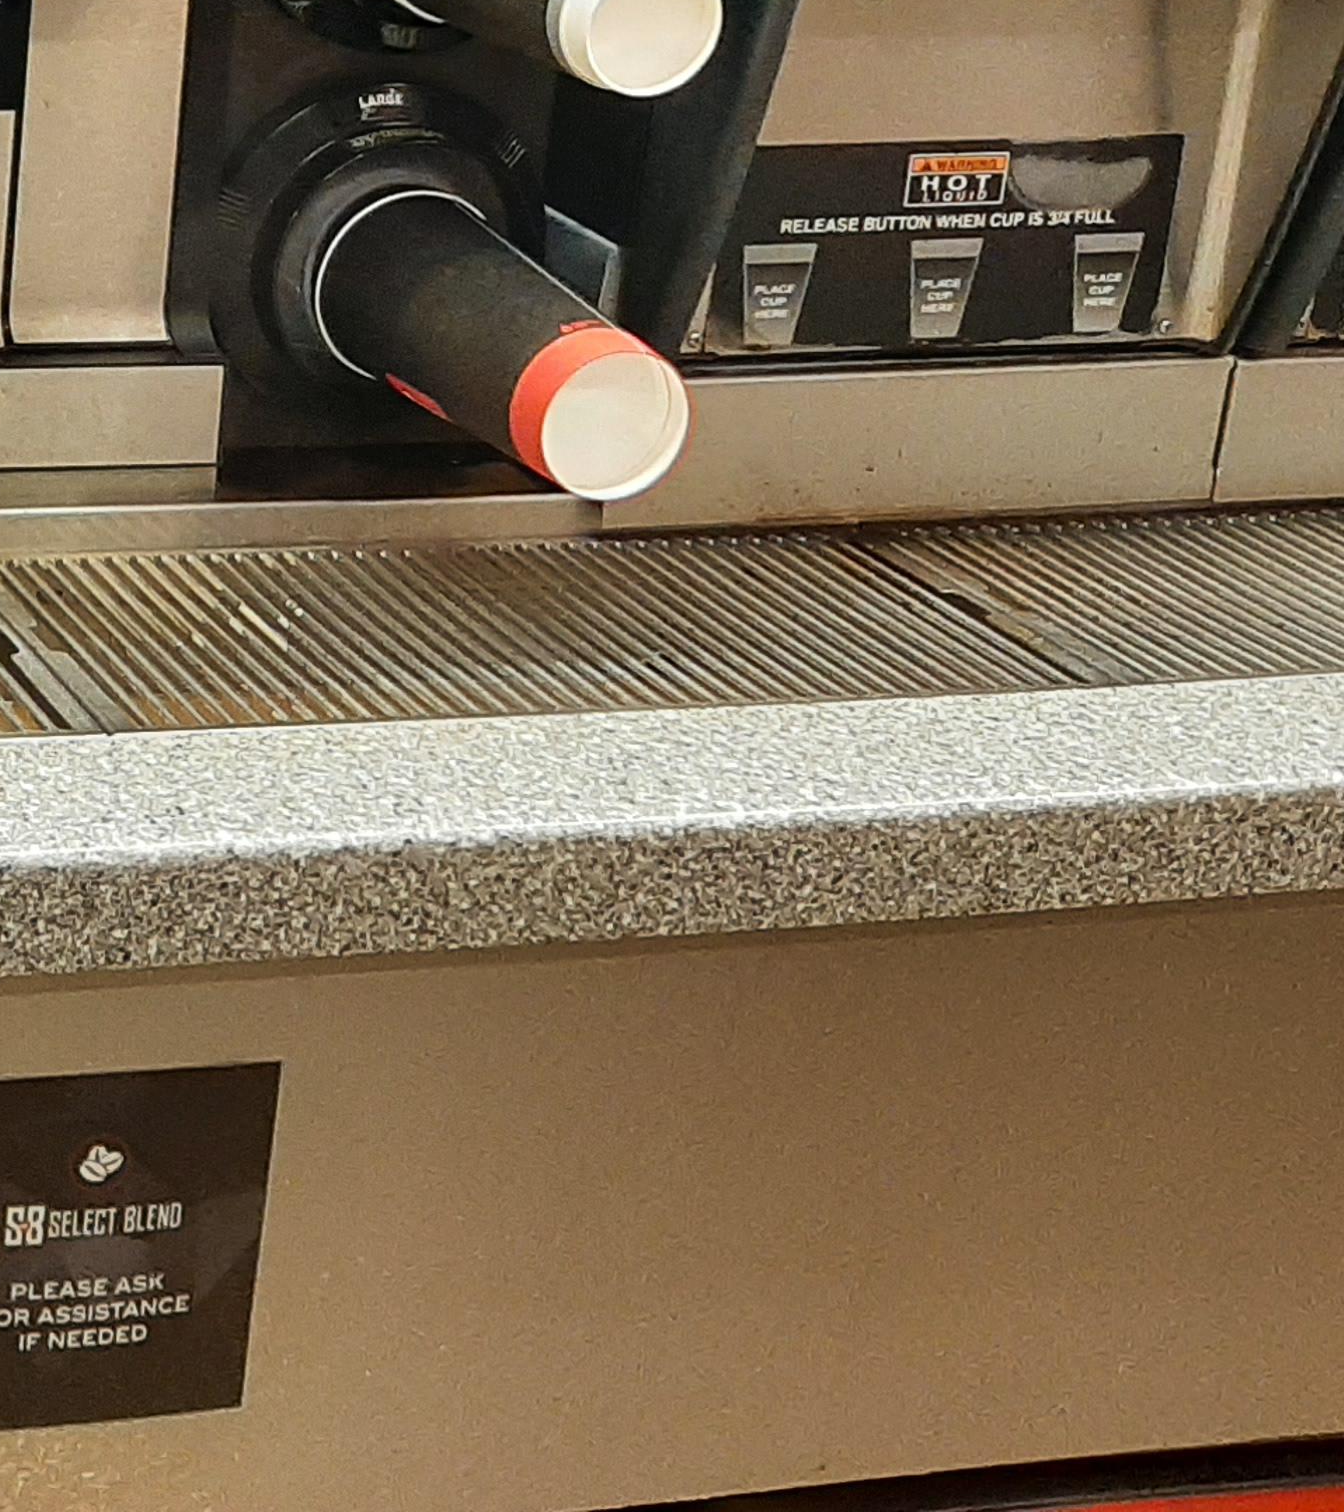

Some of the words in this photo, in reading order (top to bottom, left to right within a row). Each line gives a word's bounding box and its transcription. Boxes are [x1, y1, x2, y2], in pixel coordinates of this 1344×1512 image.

[921, 174, 992, 191] HOT
[922, 190, 987, 202] LIQUID
[780, 217, 860, 235] RELEASE
[862, 215, 931, 232] BUTTON
[936, 214, 987, 229] WHEN
[989, 212, 1024, 228] CUP
[1028, 212, 1044, 226] IS
[1074, 209, 1115, 224] FULL
[921, 278, 962, 289] PLACE
[1084, 273, 1123, 284] PLACE
[754, 284, 797, 296] PLACE
[927, 290, 954, 301] CUP
[1088, 285, 1115, 296] CUP
[760, 296, 788, 307] CUP
[1083, 297, 1116, 307] HERE
[48, 1207, 118, 1238] SELECT
[123, 1202, 182, 1234] BLEND
[10, 1277, 108, 1302] PLEASE
[113, 1273, 165, 1296] ASK
[36, 1294, 190, 1326] ASSISTANCE
[17, 1334, 42, 1352] IF
[48, 1325, 148, 1351] NEEDED
